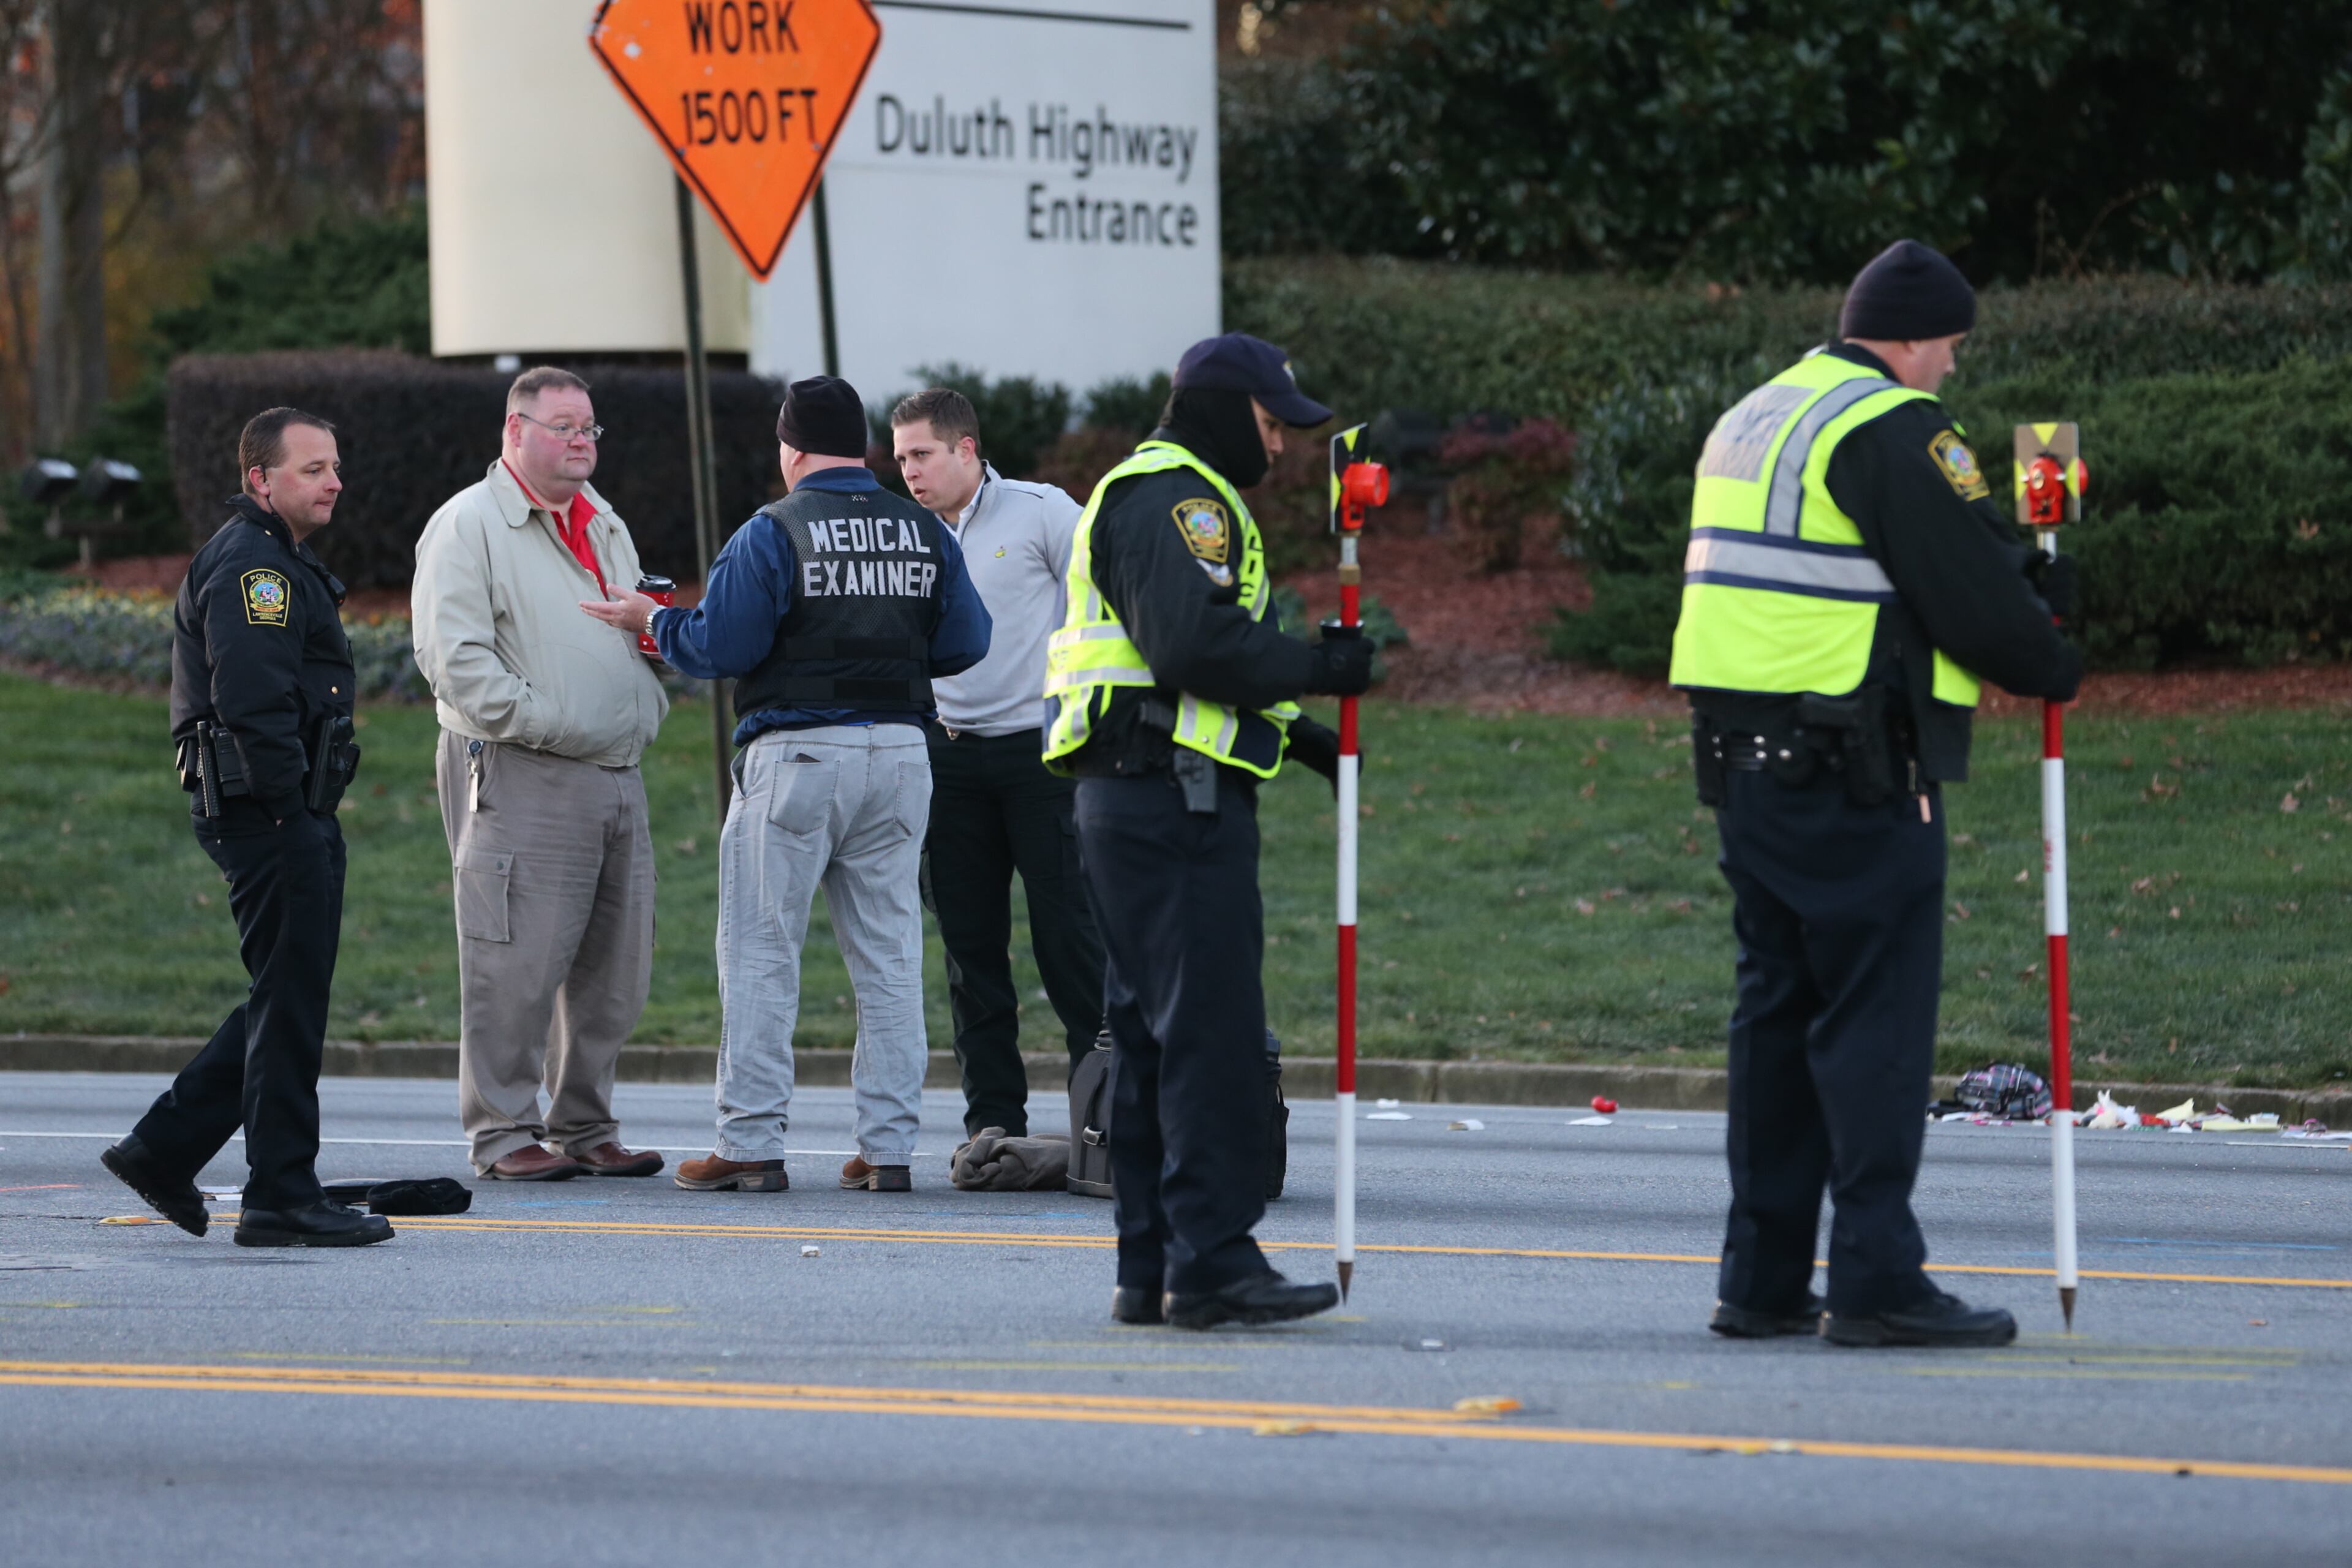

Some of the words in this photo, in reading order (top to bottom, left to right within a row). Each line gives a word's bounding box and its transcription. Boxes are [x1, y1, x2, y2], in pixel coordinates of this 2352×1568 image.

[684, 1, 799, 54] WORK
[681, 90, 768, 146] 1500
[778, 89, 818, 143] FT
[876, 94, 1014, 158] Duluth
[1030, 104, 1197, 184] Highway
[1027, 183, 1197, 245] Entrance
[808, 518, 930, 554] MEDICAL
[250, 573, 282, 584] POLICE
[803, 560, 937, 598] EXAMINER
